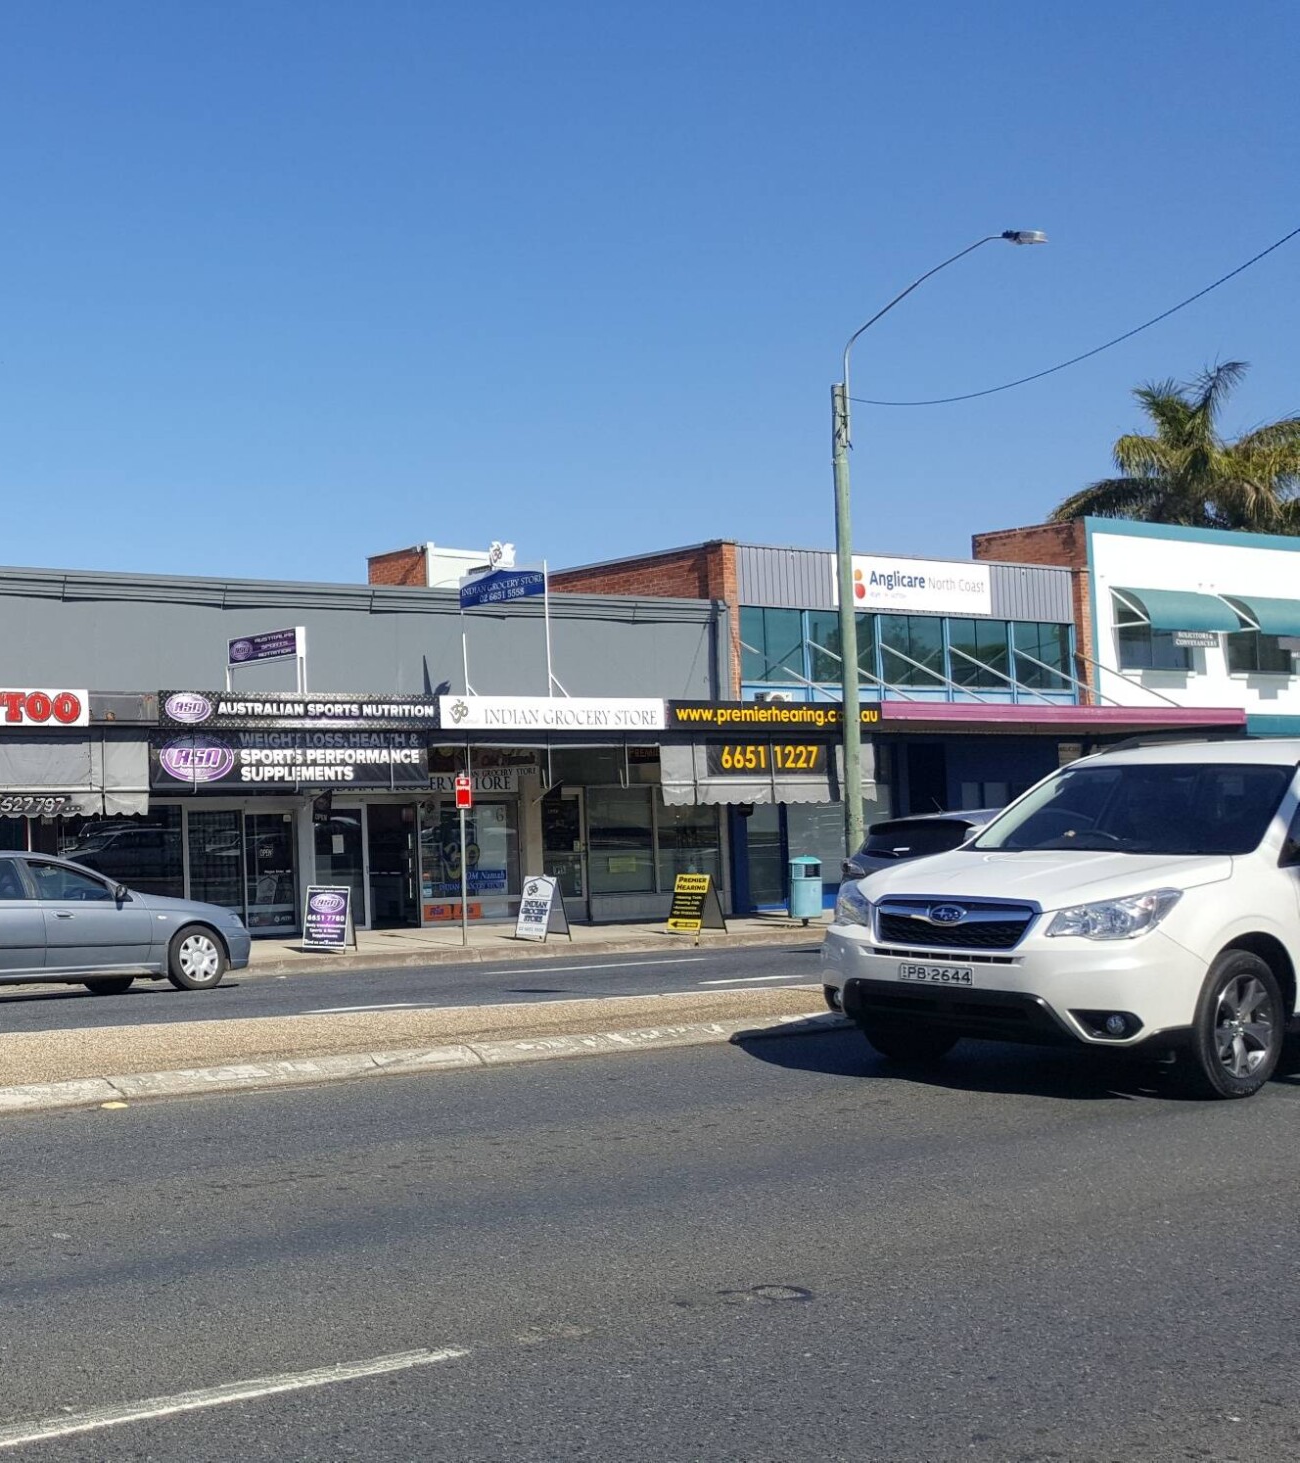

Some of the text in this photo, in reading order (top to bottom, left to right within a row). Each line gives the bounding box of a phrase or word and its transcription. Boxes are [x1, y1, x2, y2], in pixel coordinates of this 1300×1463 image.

[461, 573, 544, 597] INDIAN GROCERY STORE
[870, 570, 985, 593] Anglicare North Coast
[217, 701, 304, 716] AUSTRALIAN
[307, 703, 360, 716] SPORTS
[362, 704, 434, 717] NUTRITION
[484, 708, 658, 726] INDIAN GROCERY STORE
[240, 731, 300, 747] WEIGHT
[349, 733, 406, 747] HEALTH
[408, 733, 419, 747] &
[240, 748, 420, 764] SPORTS PERFORMANCE
[721, 745, 818, 769] 6651 1227
[240, 766, 355, 781] SUPPLEMENTS
